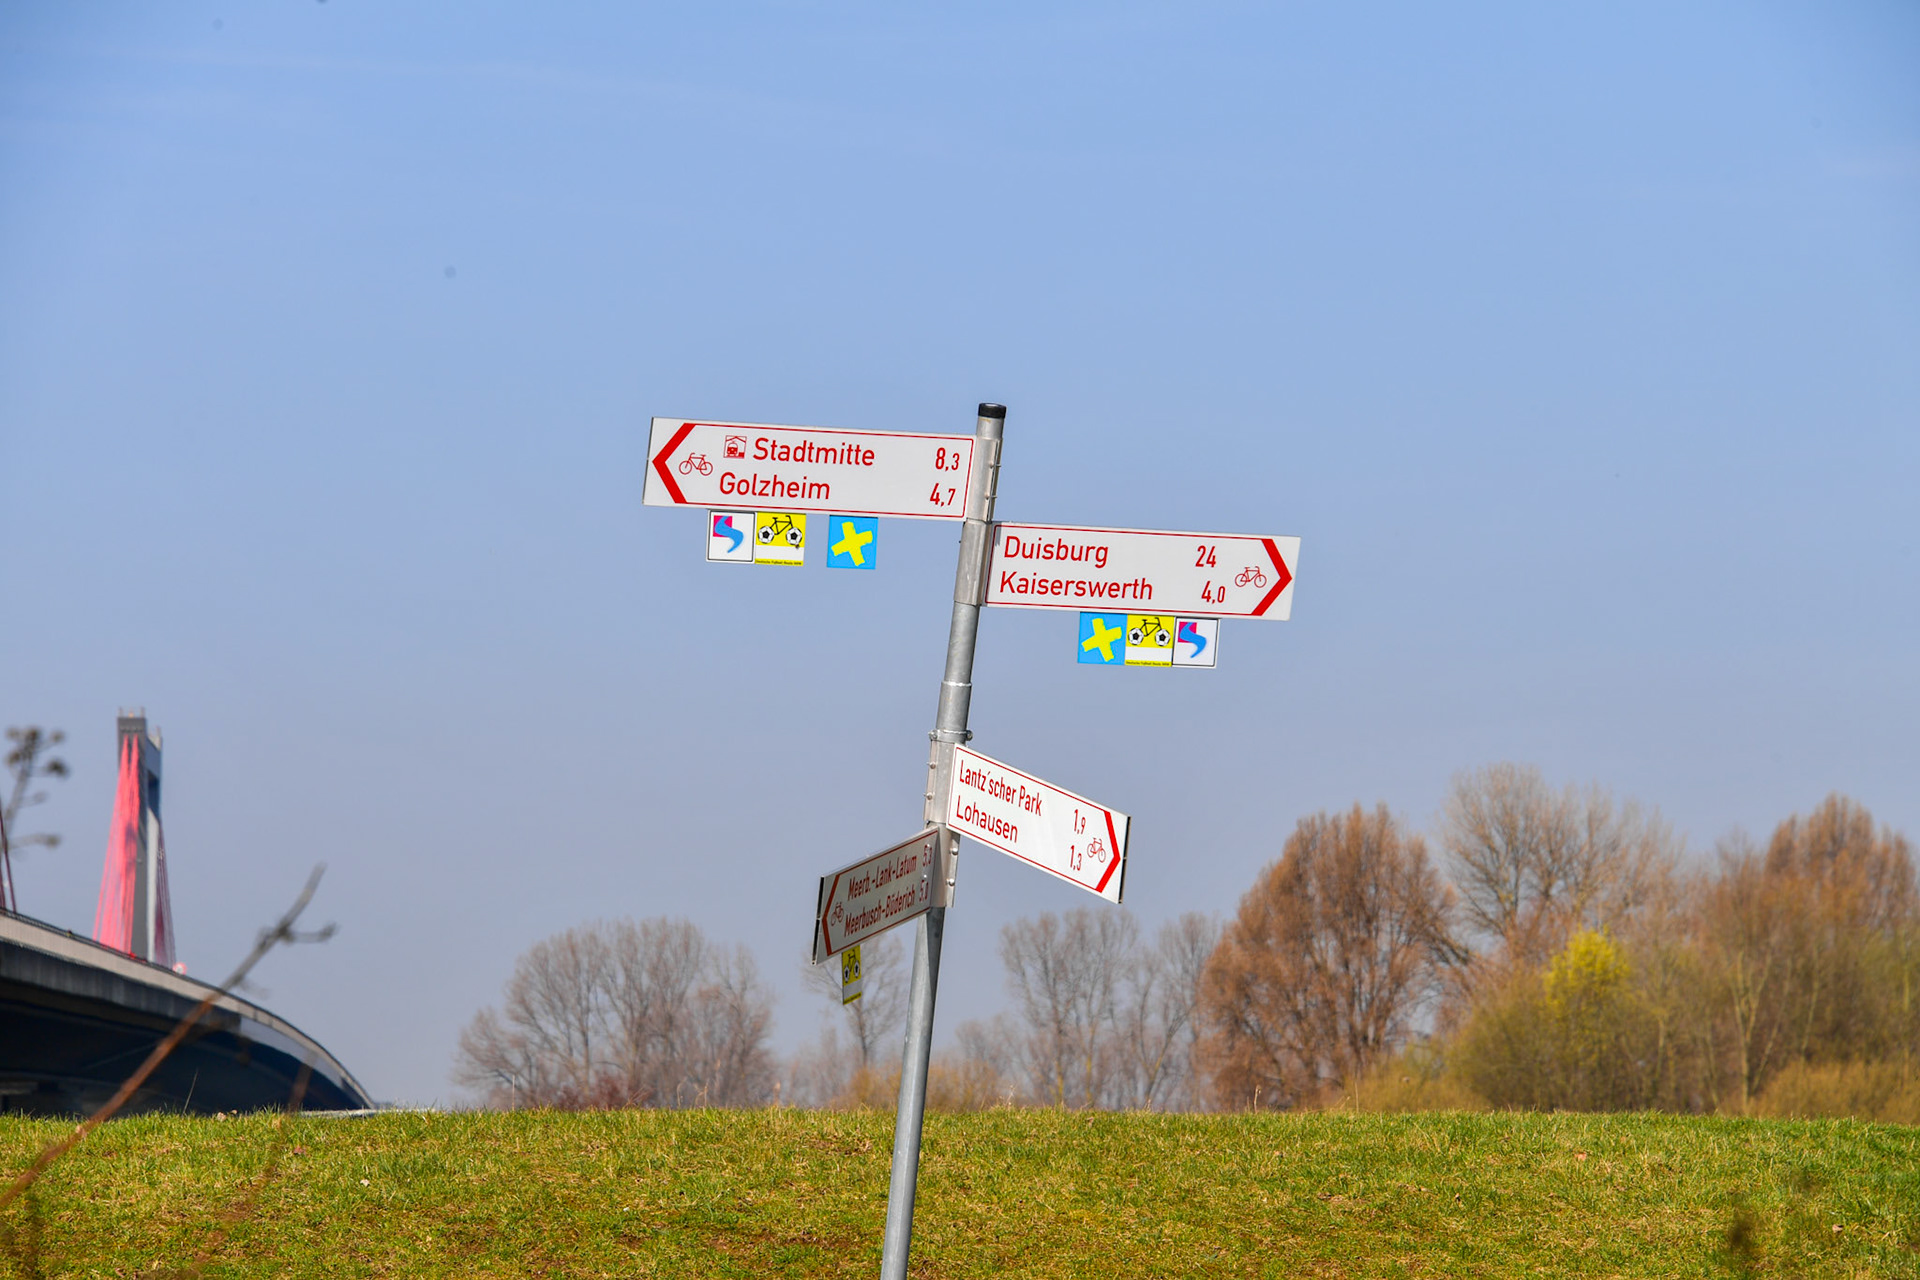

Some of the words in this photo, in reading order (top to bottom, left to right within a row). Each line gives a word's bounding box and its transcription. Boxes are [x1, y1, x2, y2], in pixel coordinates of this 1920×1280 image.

[753, 437, 875, 466] Stadtmitte
[936, 447, 960, 471] 8,3
[719, 472, 830, 500] Golzheim
[930, 482, 956, 506] 4,7
[1004, 536, 1108, 568] Duisburg
[1196, 545, 1217, 568] 24
[1000, 571, 1152, 600] Kaiserswerth
[1201, 581, 1226, 604] 4,0
[1018, 785, 1042, 816] Park
[1074, 809, 1086, 834] 1,9
[956, 795, 1018, 843] Lohausen
[1070, 845, 1082, 871] 1,3
